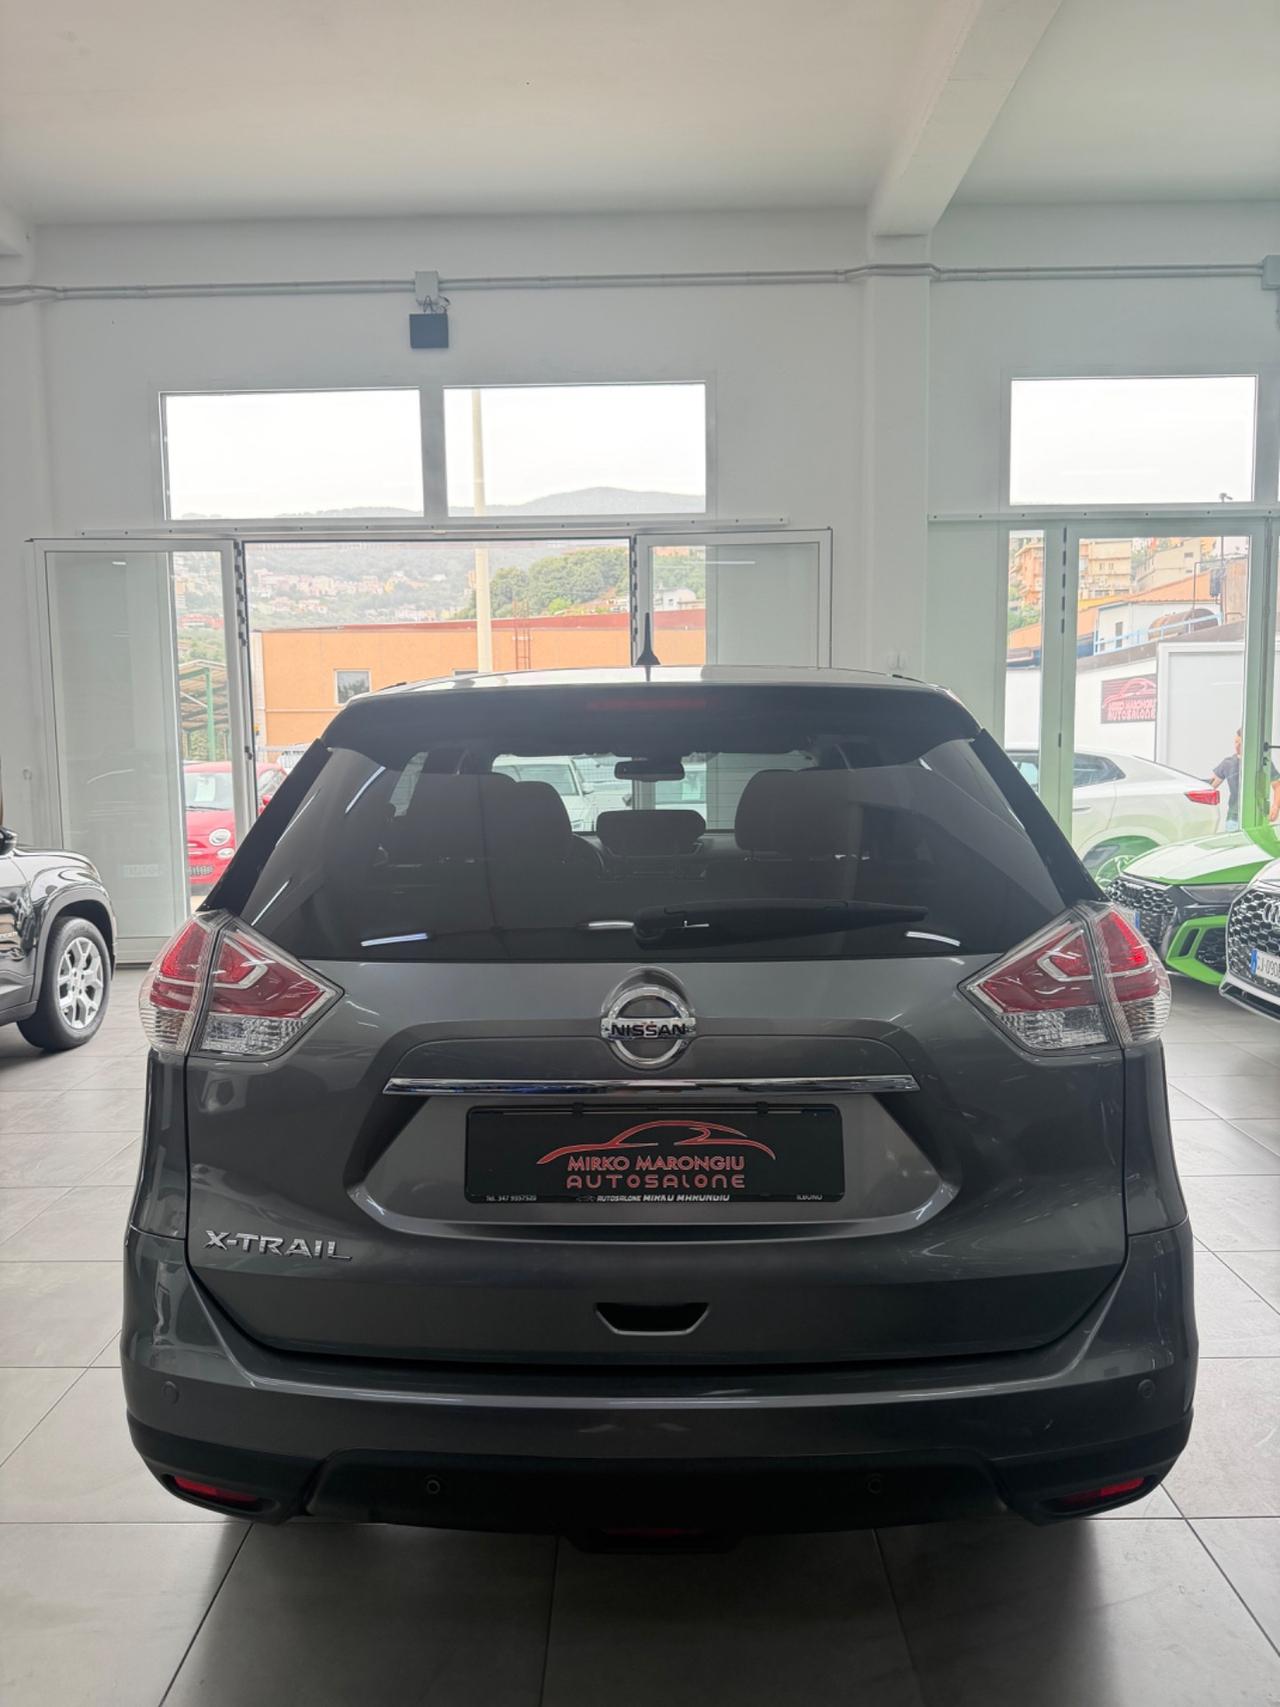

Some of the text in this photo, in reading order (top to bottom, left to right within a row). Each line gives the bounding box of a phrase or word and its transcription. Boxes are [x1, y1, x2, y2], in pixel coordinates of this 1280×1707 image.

[610, 1023, 686, 1037] NISSAN
[567, 1155, 745, 1172] MIRKO MARONGIU
[566, 1174, 745, 1189] AUTOSALONE
[204, 1230, 352, 1261] X-TRAIL
